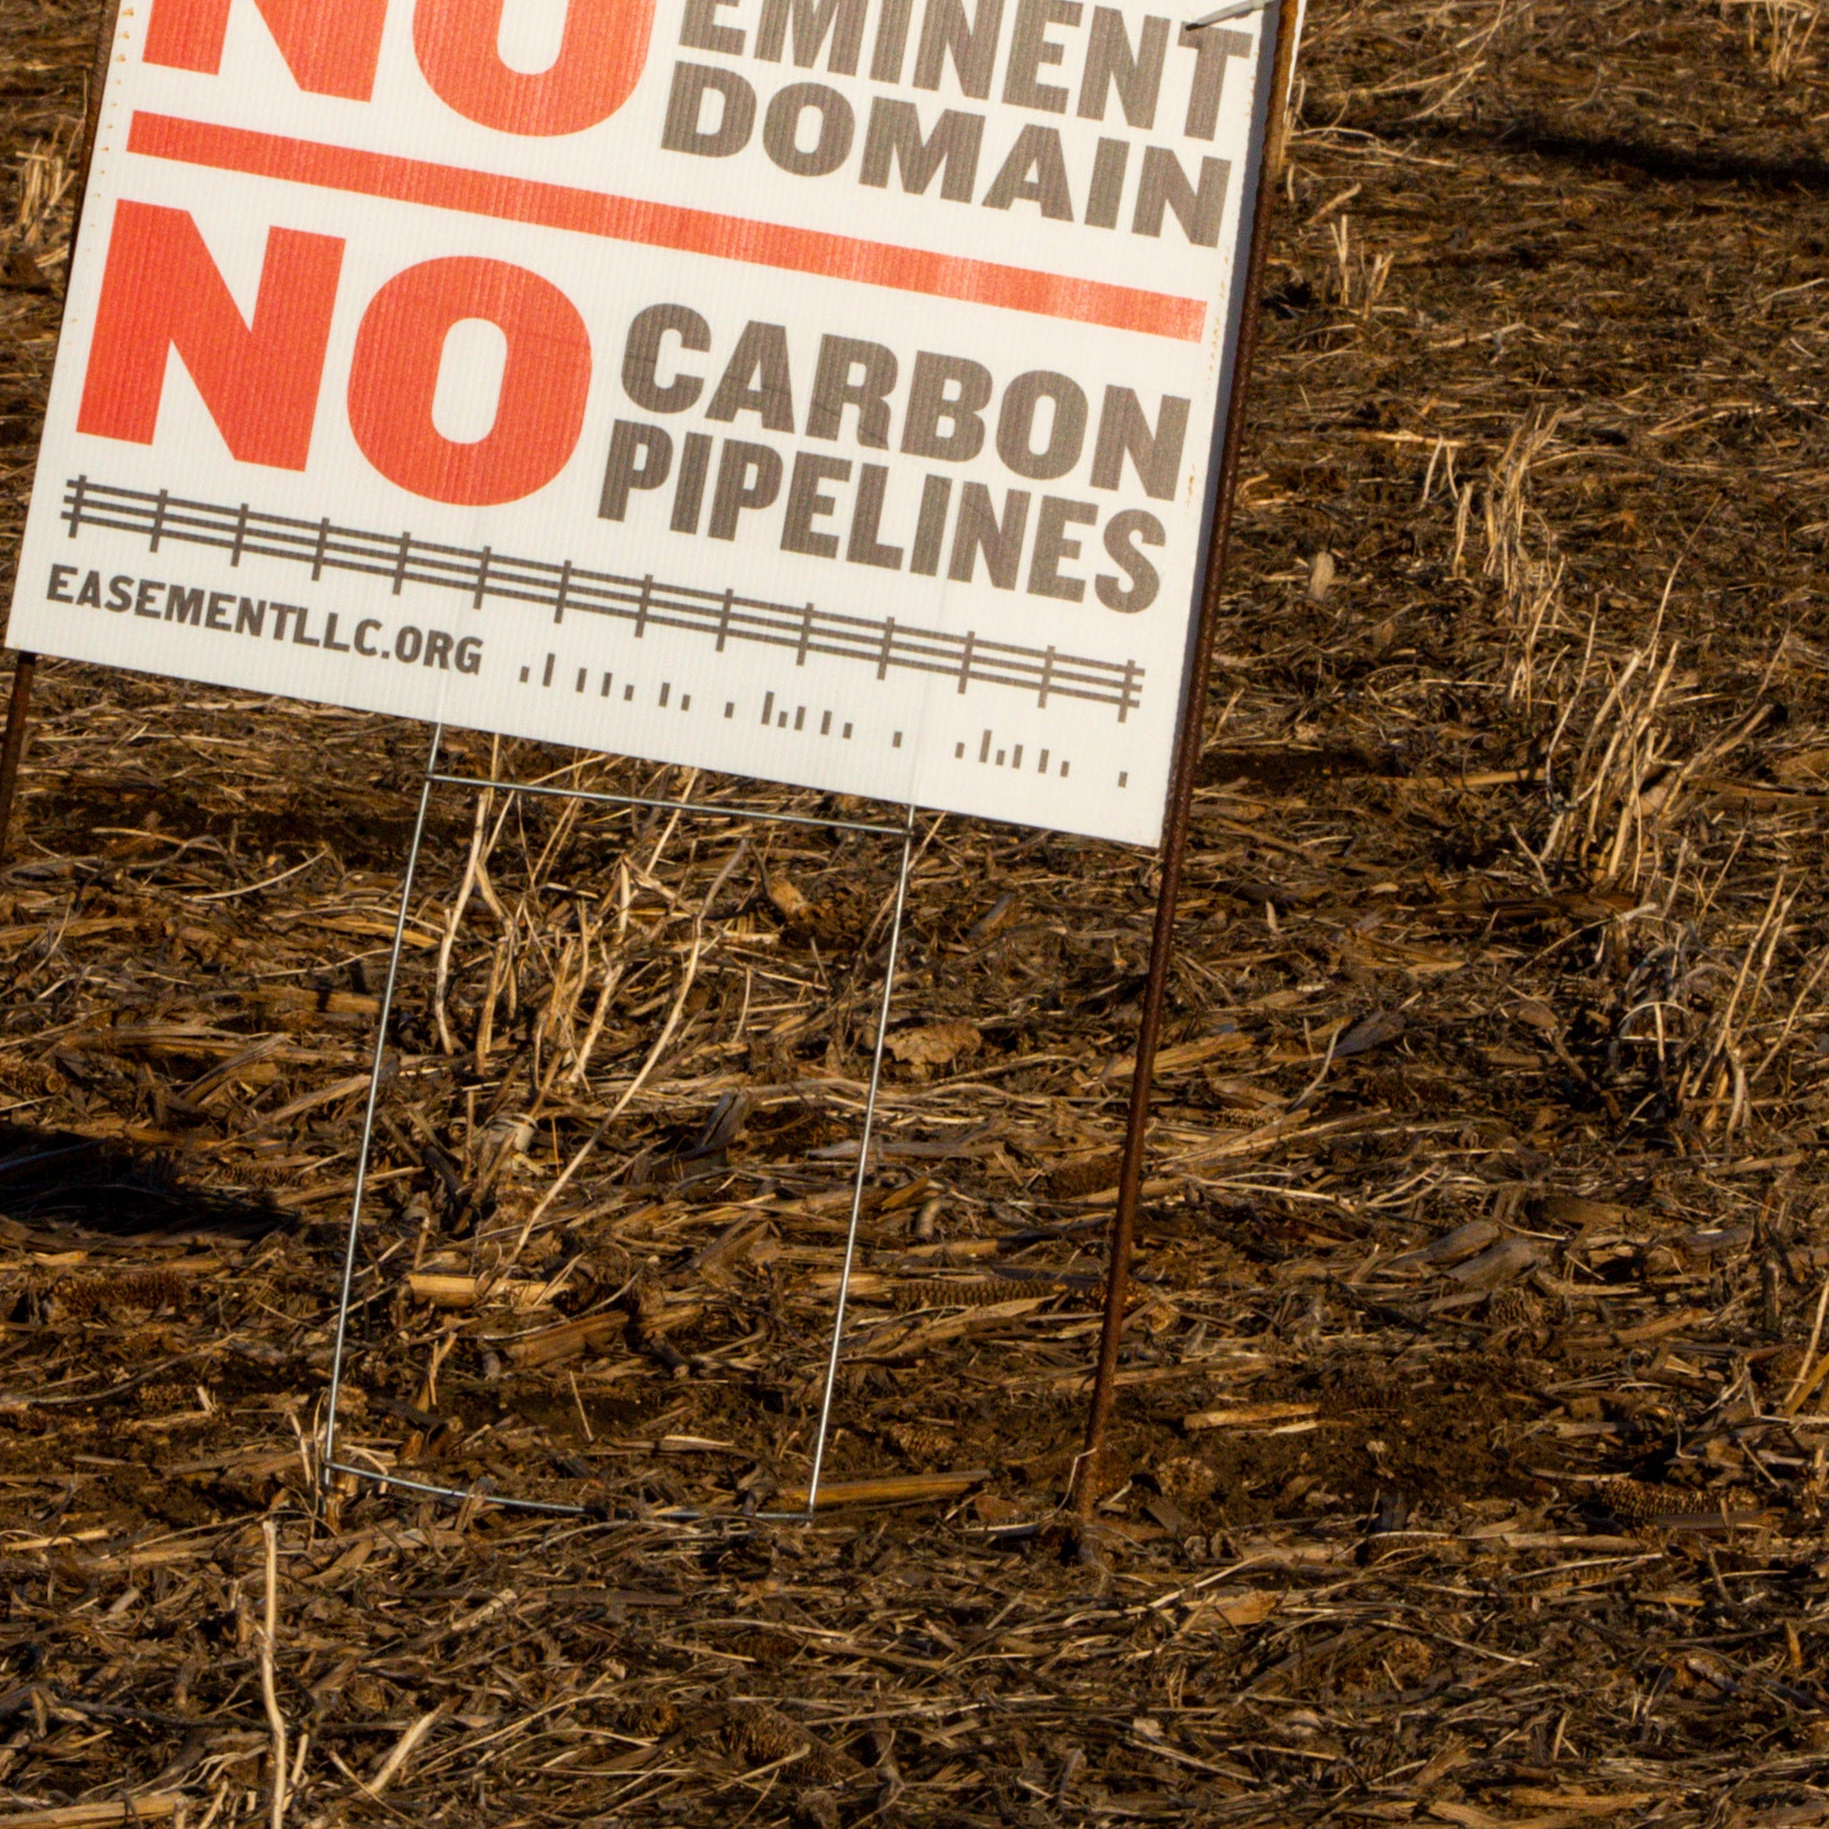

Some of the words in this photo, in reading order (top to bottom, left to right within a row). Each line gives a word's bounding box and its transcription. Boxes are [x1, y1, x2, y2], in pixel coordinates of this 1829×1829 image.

[661, 60, 1231, 248] DOMAIN
[76, 198, 593, 507] NO
[620, 303, 1191, 501] CARBON
[597, 419, 1167, 614] PIPELINES
[45, 563, 484, 676] EASEMENTLLC.ORG
